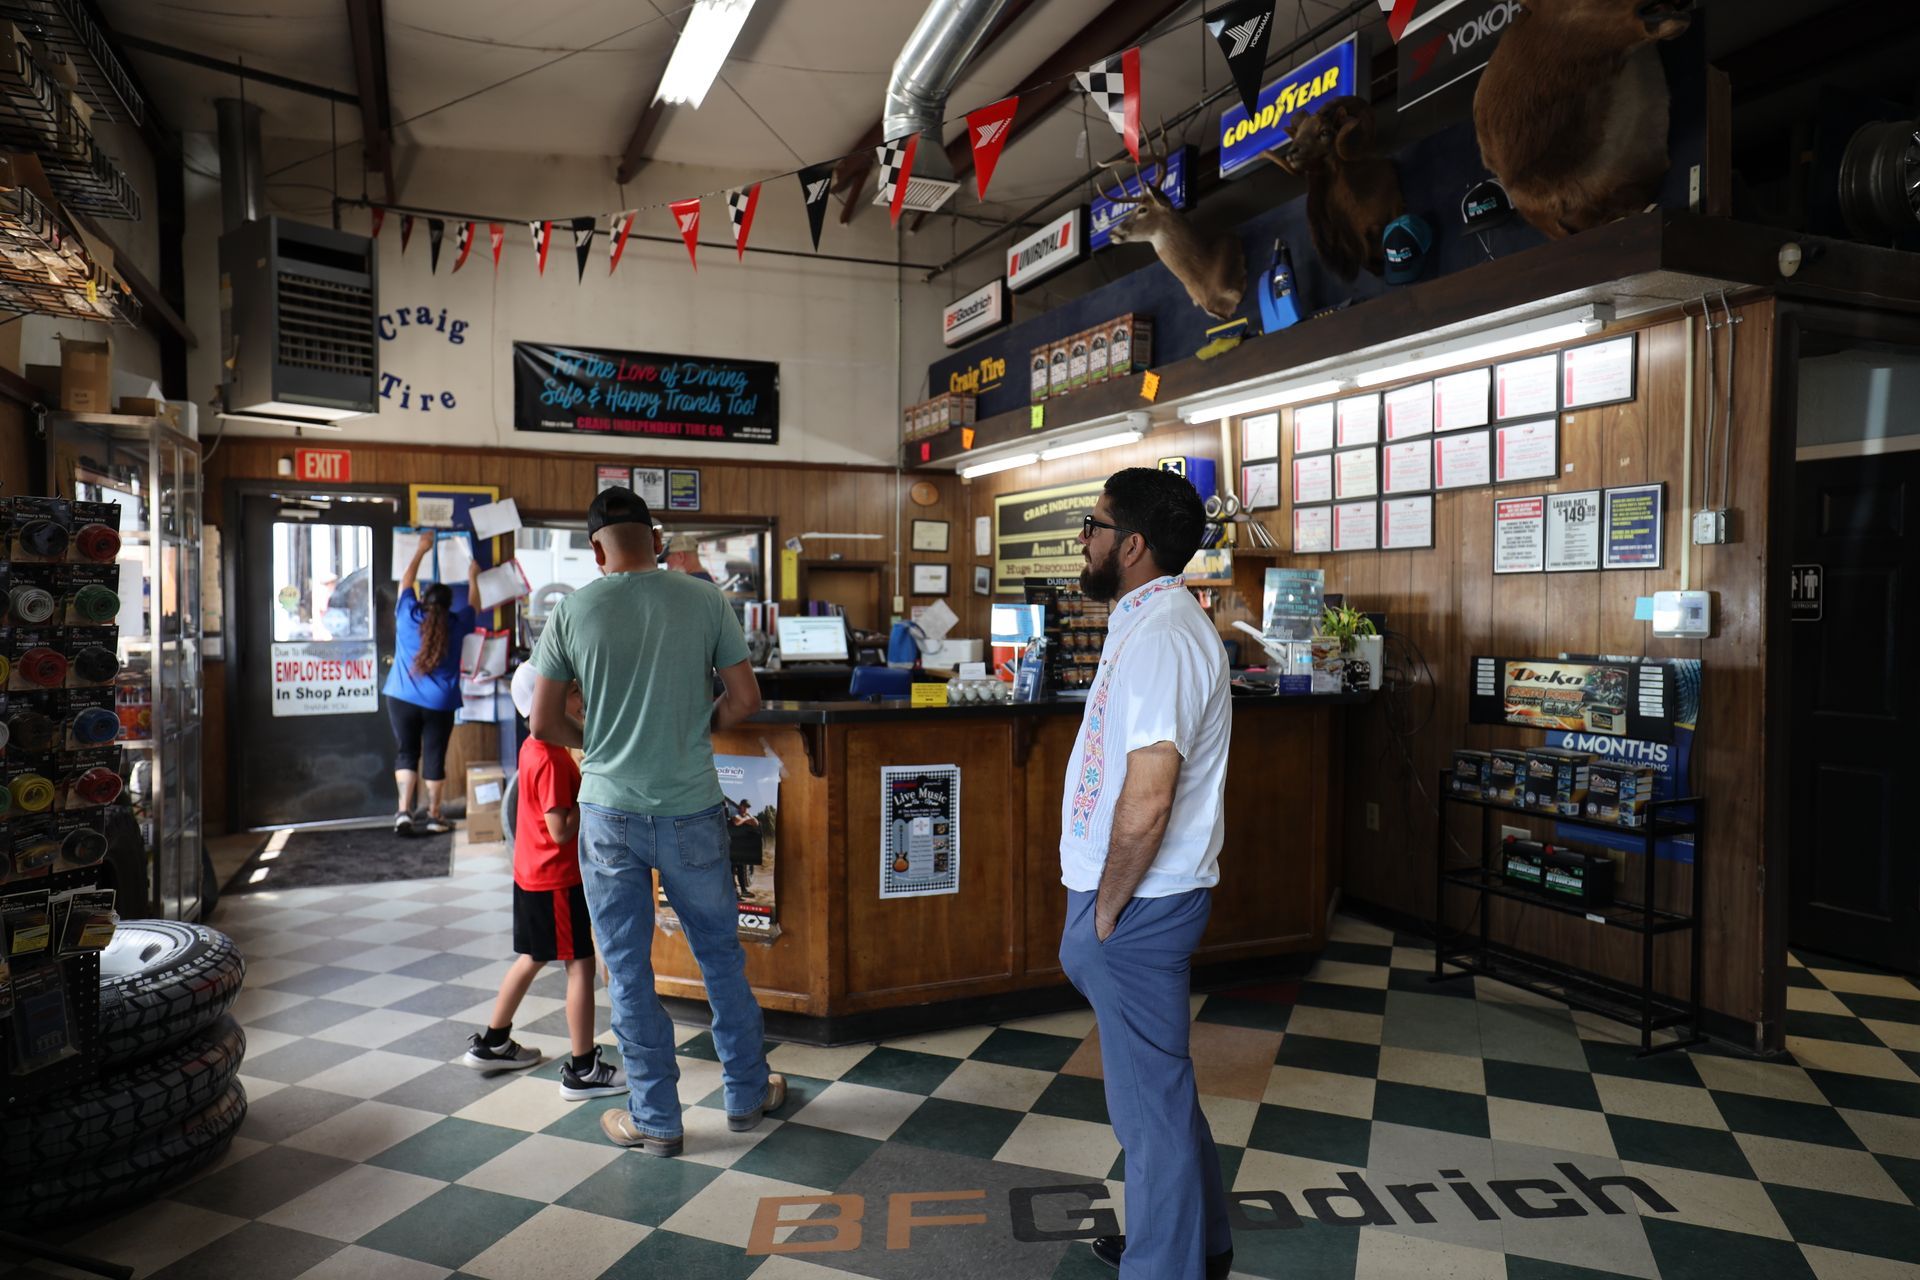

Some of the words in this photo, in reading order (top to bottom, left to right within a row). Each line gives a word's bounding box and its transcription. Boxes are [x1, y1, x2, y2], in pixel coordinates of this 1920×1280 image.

[1250, 11, 1271, 47] YOKOHAMA
[1448, 0, 1522, 54] YOKOH
[1223, 66, 1339, 148] GOODYEAR
[1019, 230, 1059, 270] UNIROYAL
[379, 306, 469, 344] Craig
[947, 294, 992, 326] BFGoodrich
[553, 352, 584, 376] For
[586, 357, 616, 378] the
[616, 358, 657, 382] Love
[660, 363, 679, 388] of
[683, 362, 749, 395] Driving
[951, 366, 979, 394] Craig
[980, 356, 1006, 384] Tire
[379, 372, 456, 411] Tire
[540, 378, 585, 408] Safe
[586, 383, 601, 408] &
[605, 384, 661, 418] Happy
[664, 390, 722, 414] Travels
[726, 395, 758, 415] Too!
[577, 416, 610, 431] CRAIG
[613, 418, 682, 434] INDEPENDENT
[685, 423, 707, 436] TIRE
[304, 453, 342, 479] EXIT
[1023, 503, 1048, 522] CRAIG
[1049, 496, 1099, 513] INDEPENDE
[1553, 500, 1572, 509] LABOR
[1574, 498, 1588, 507] RATE
[1032, 540, 1065, 557] Annual
[1006, 564, 1031, 576] Huge
[1033, 561, 1084, 574] Discounts
[276, 660, 342, 682] EMPLOYEES
[345, 659, 373, 681] ONLY
[1509, 668, 1584, 686] Deka
[277, 688, 290, 700] In
[296, 686, 331, 701] Shop
[337, 684, 374, 698] Area!
[1562, 733, 1575, 749] 6
[1577, 734, 1668, 762] MONTHS
[894, 791, 916, 806] Live
[918, 787, 948, 804] Music
[745, 1162, 1680, 1255] BFGodrich
